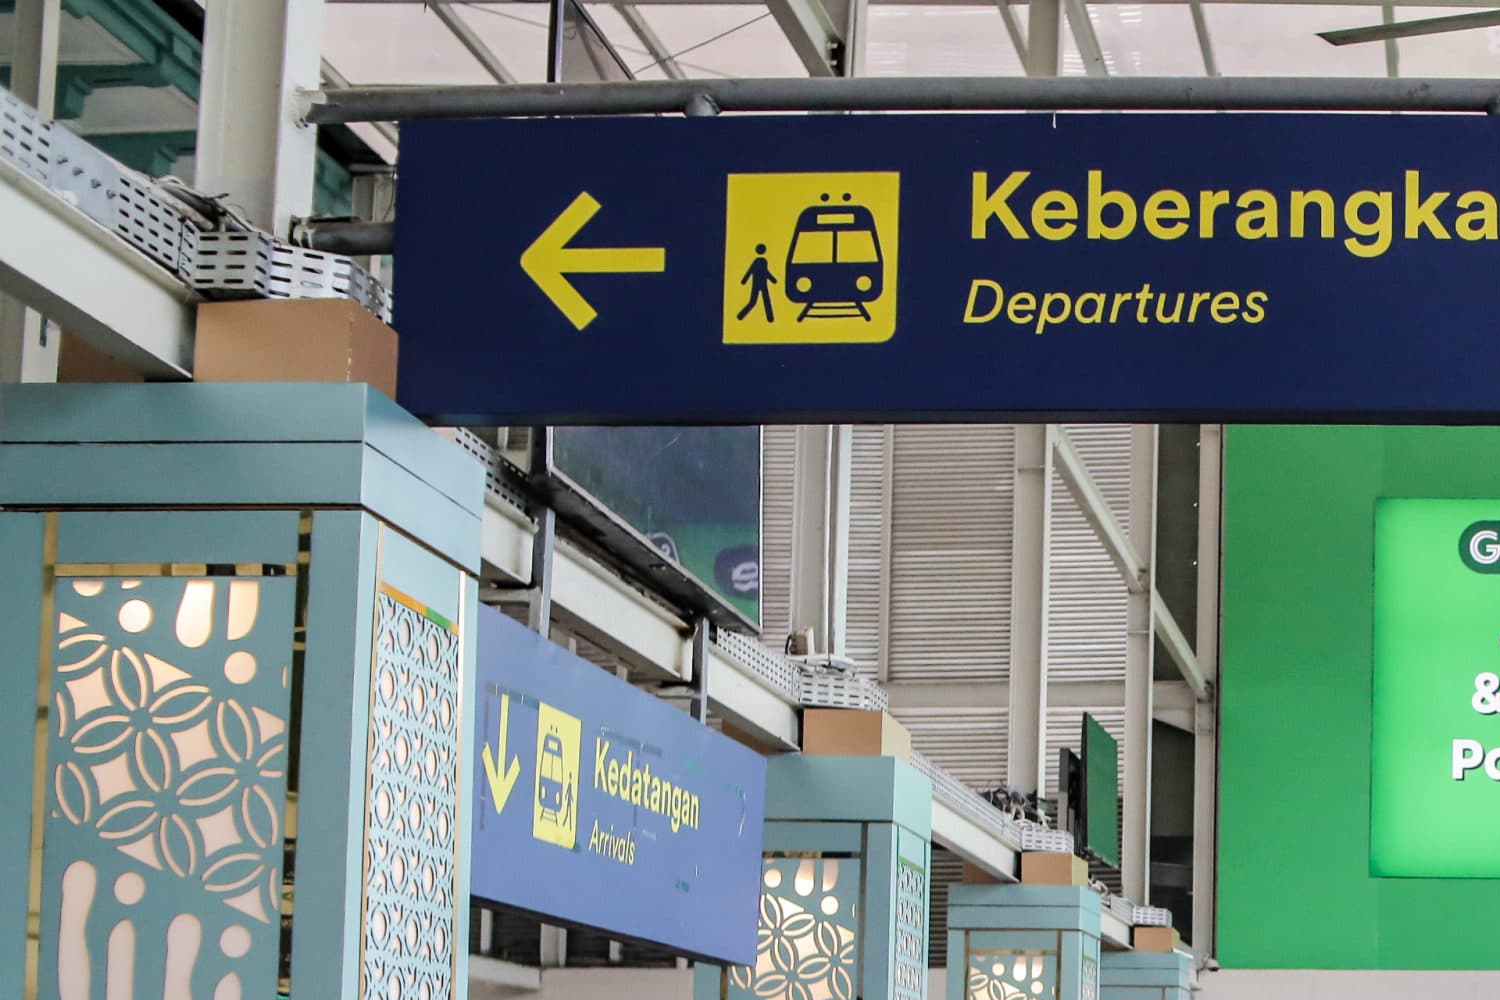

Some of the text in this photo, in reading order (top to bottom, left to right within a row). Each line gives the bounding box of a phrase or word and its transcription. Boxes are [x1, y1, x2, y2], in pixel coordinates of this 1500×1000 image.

[963, 279, 1269, 334] Departures
[593, 736, 700, 832] Kedatangan
[588, 819, 636, 865] Arrivals
